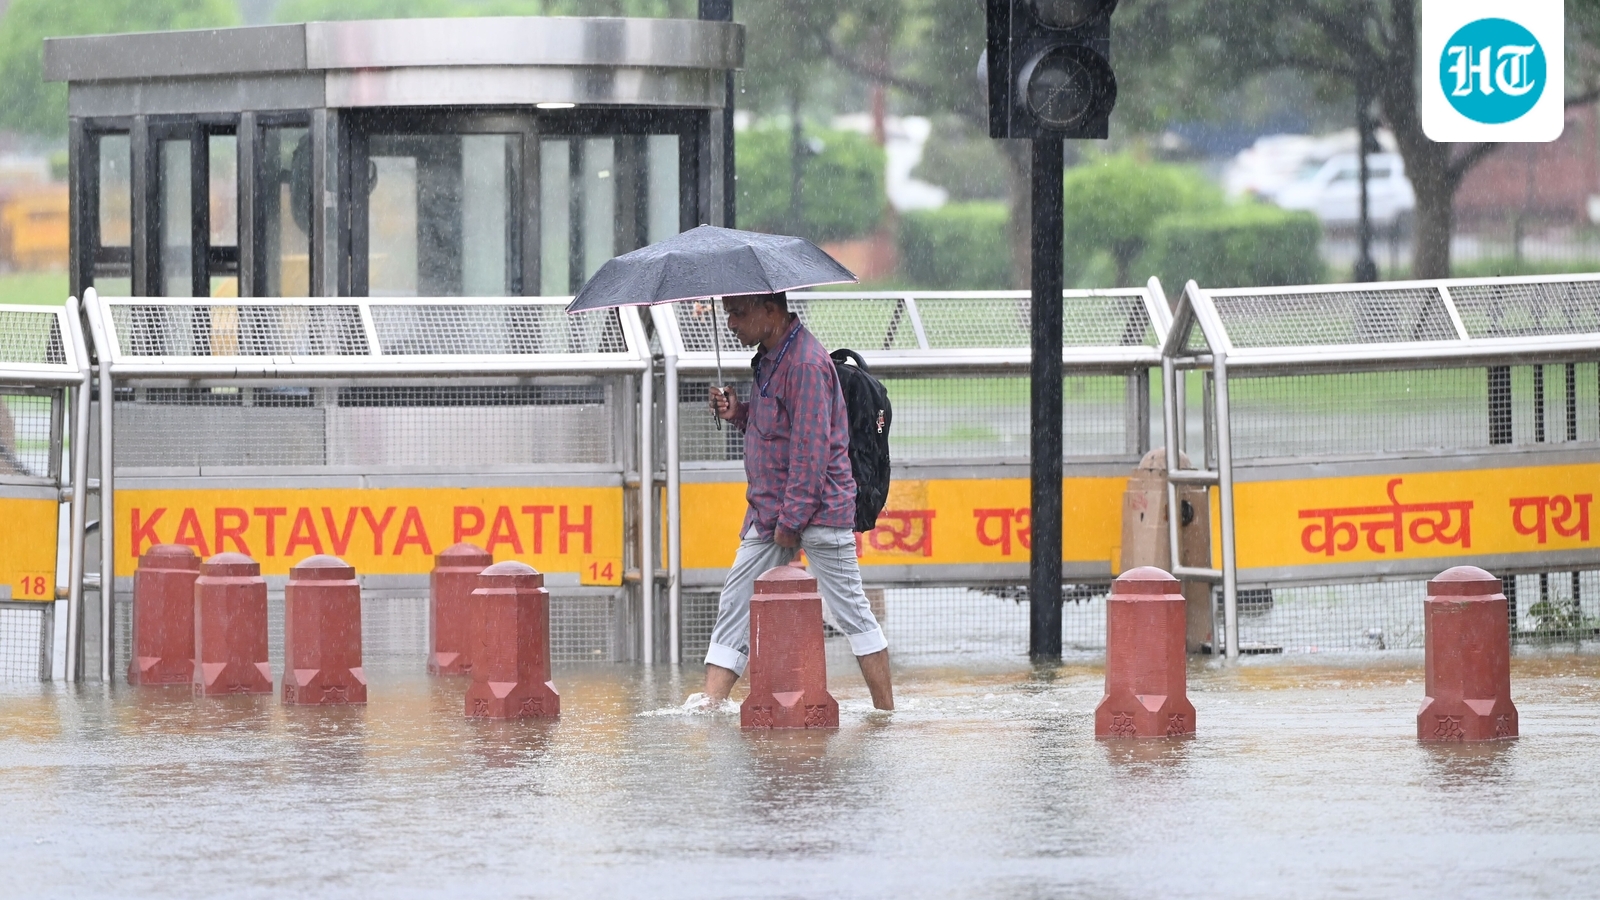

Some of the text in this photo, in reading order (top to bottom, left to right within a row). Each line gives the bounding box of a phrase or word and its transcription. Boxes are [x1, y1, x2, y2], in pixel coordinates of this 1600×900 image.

[131, 505, 593, 557] KARTAVYA PATH
[1509, 493, 1593, 544] पथ
[20, 575, 46, 596] 18
[588, 561, 614, 581] 14
